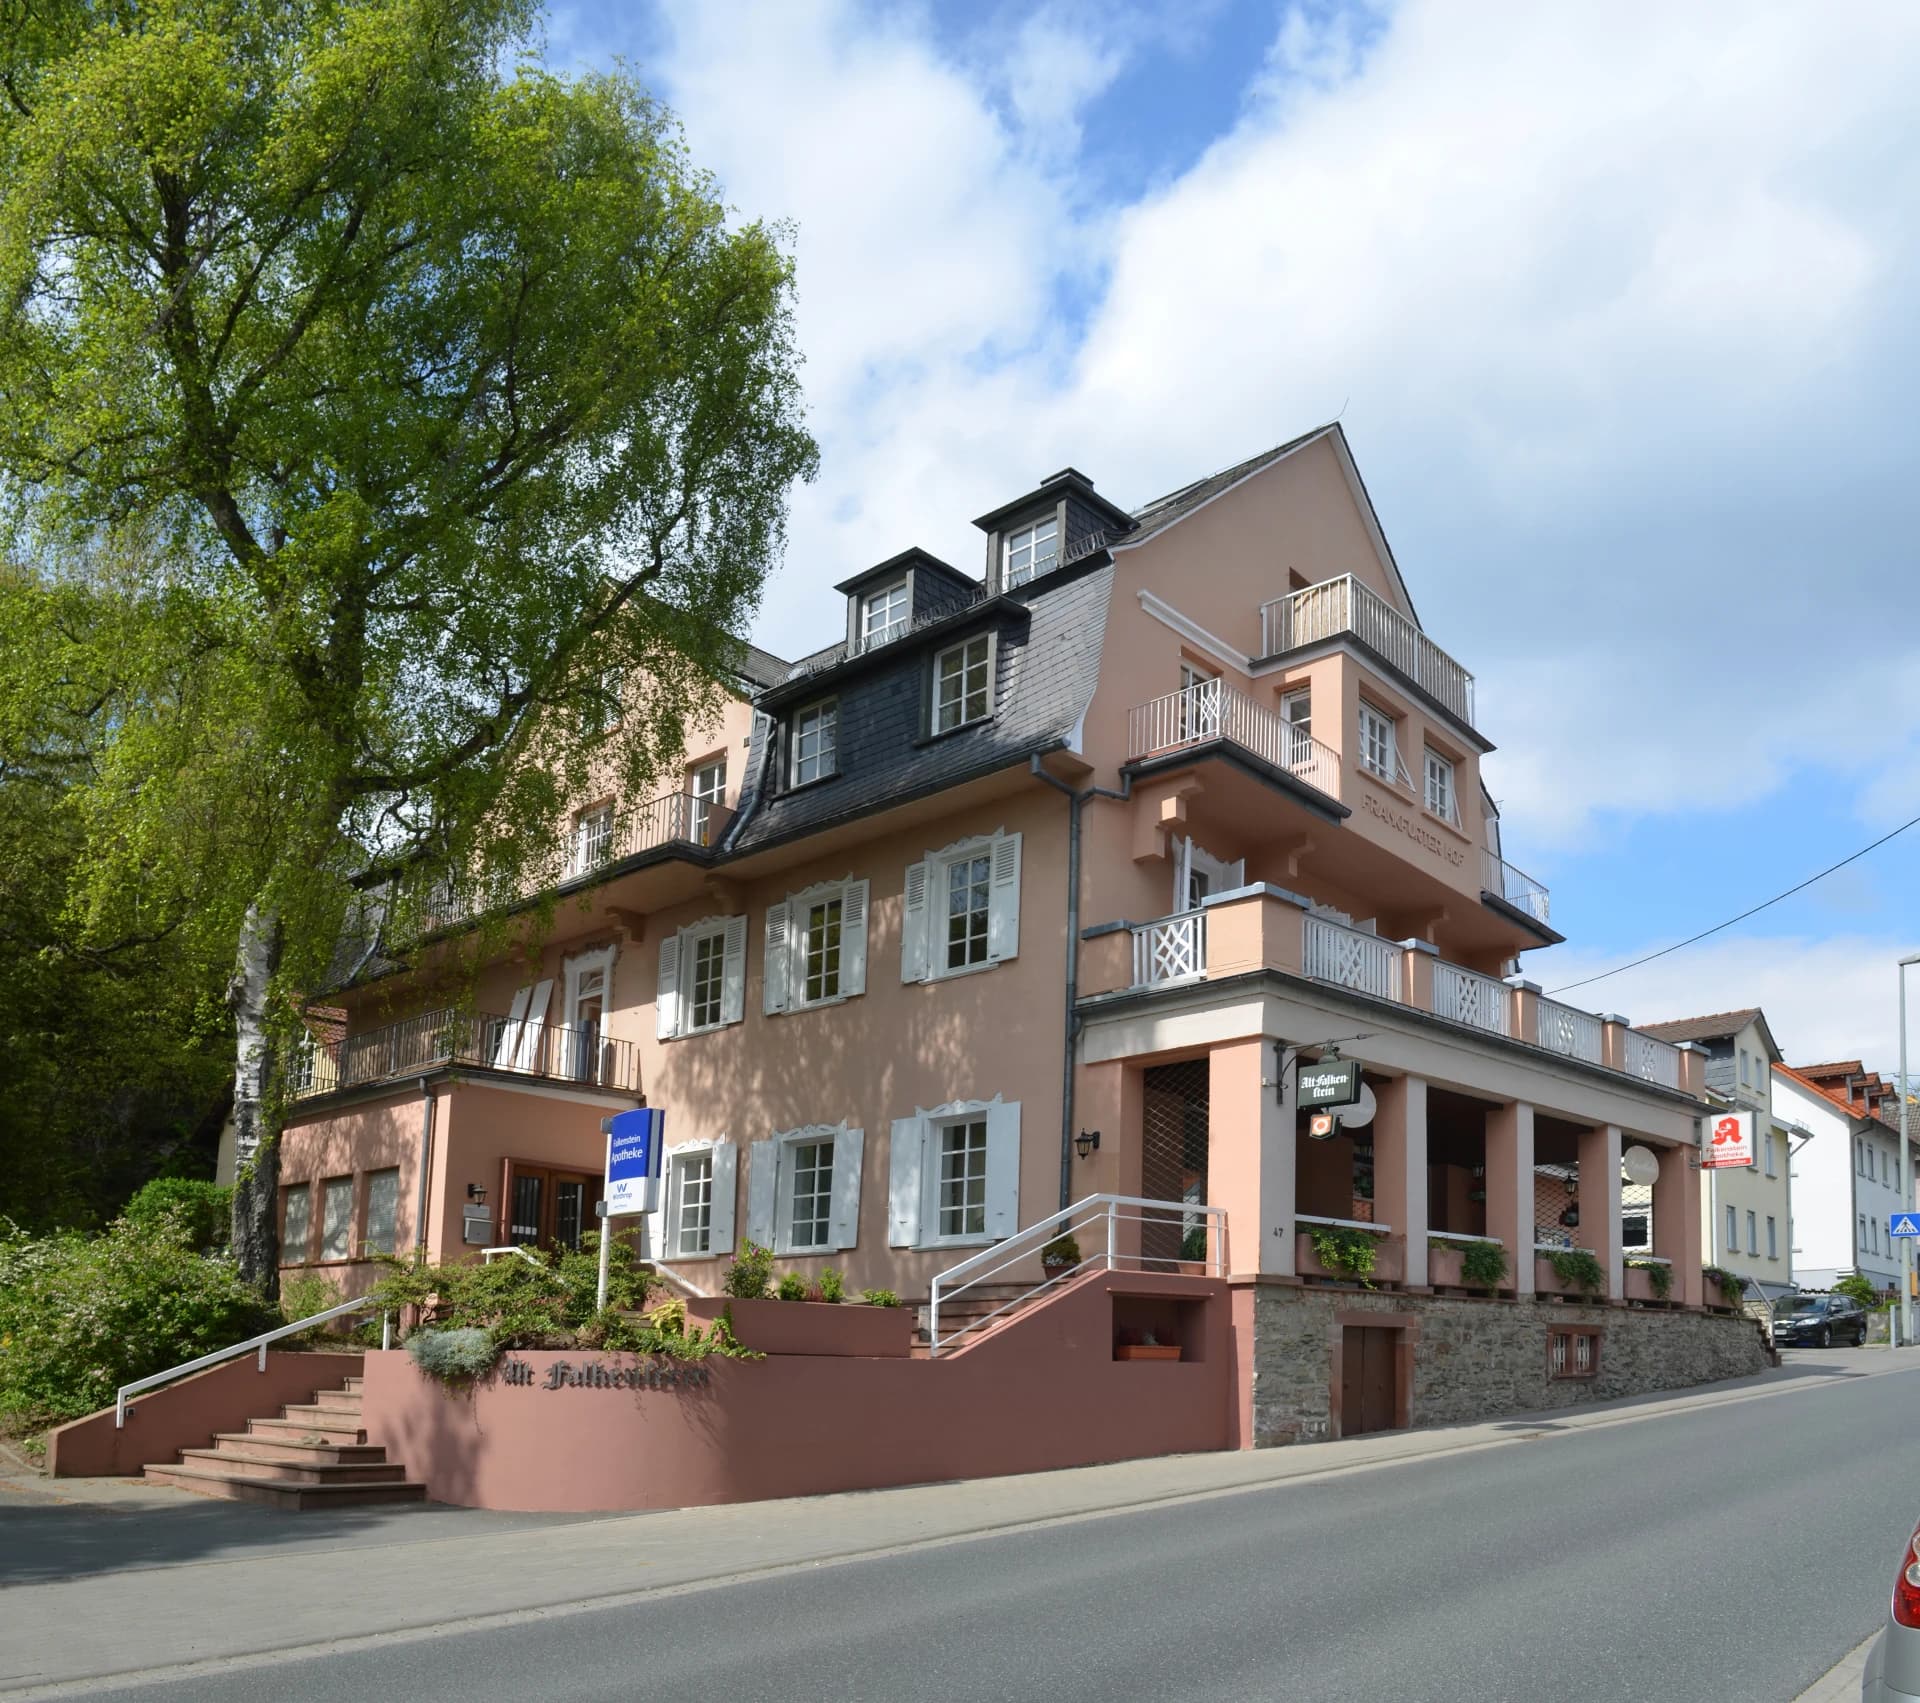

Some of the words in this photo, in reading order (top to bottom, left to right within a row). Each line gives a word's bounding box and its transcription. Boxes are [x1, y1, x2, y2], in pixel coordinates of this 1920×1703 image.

[1361, 794, 1442, 857] FRANKFURTER
[1443, 843, 1465, 868] HOF
[1301, 1076, 1317, 1089] Alt
[1313, 1086, 1335, 1098] stein
[613, 1135, 641, 1148] Falkenstein
[611, 1147, 643, 1166] Apotheke
[1273, 1227, 1284, 1238] 47
[503, 1359, 536, 1386] Alt
[542, 1360, 710, 1390] Falkenstein
